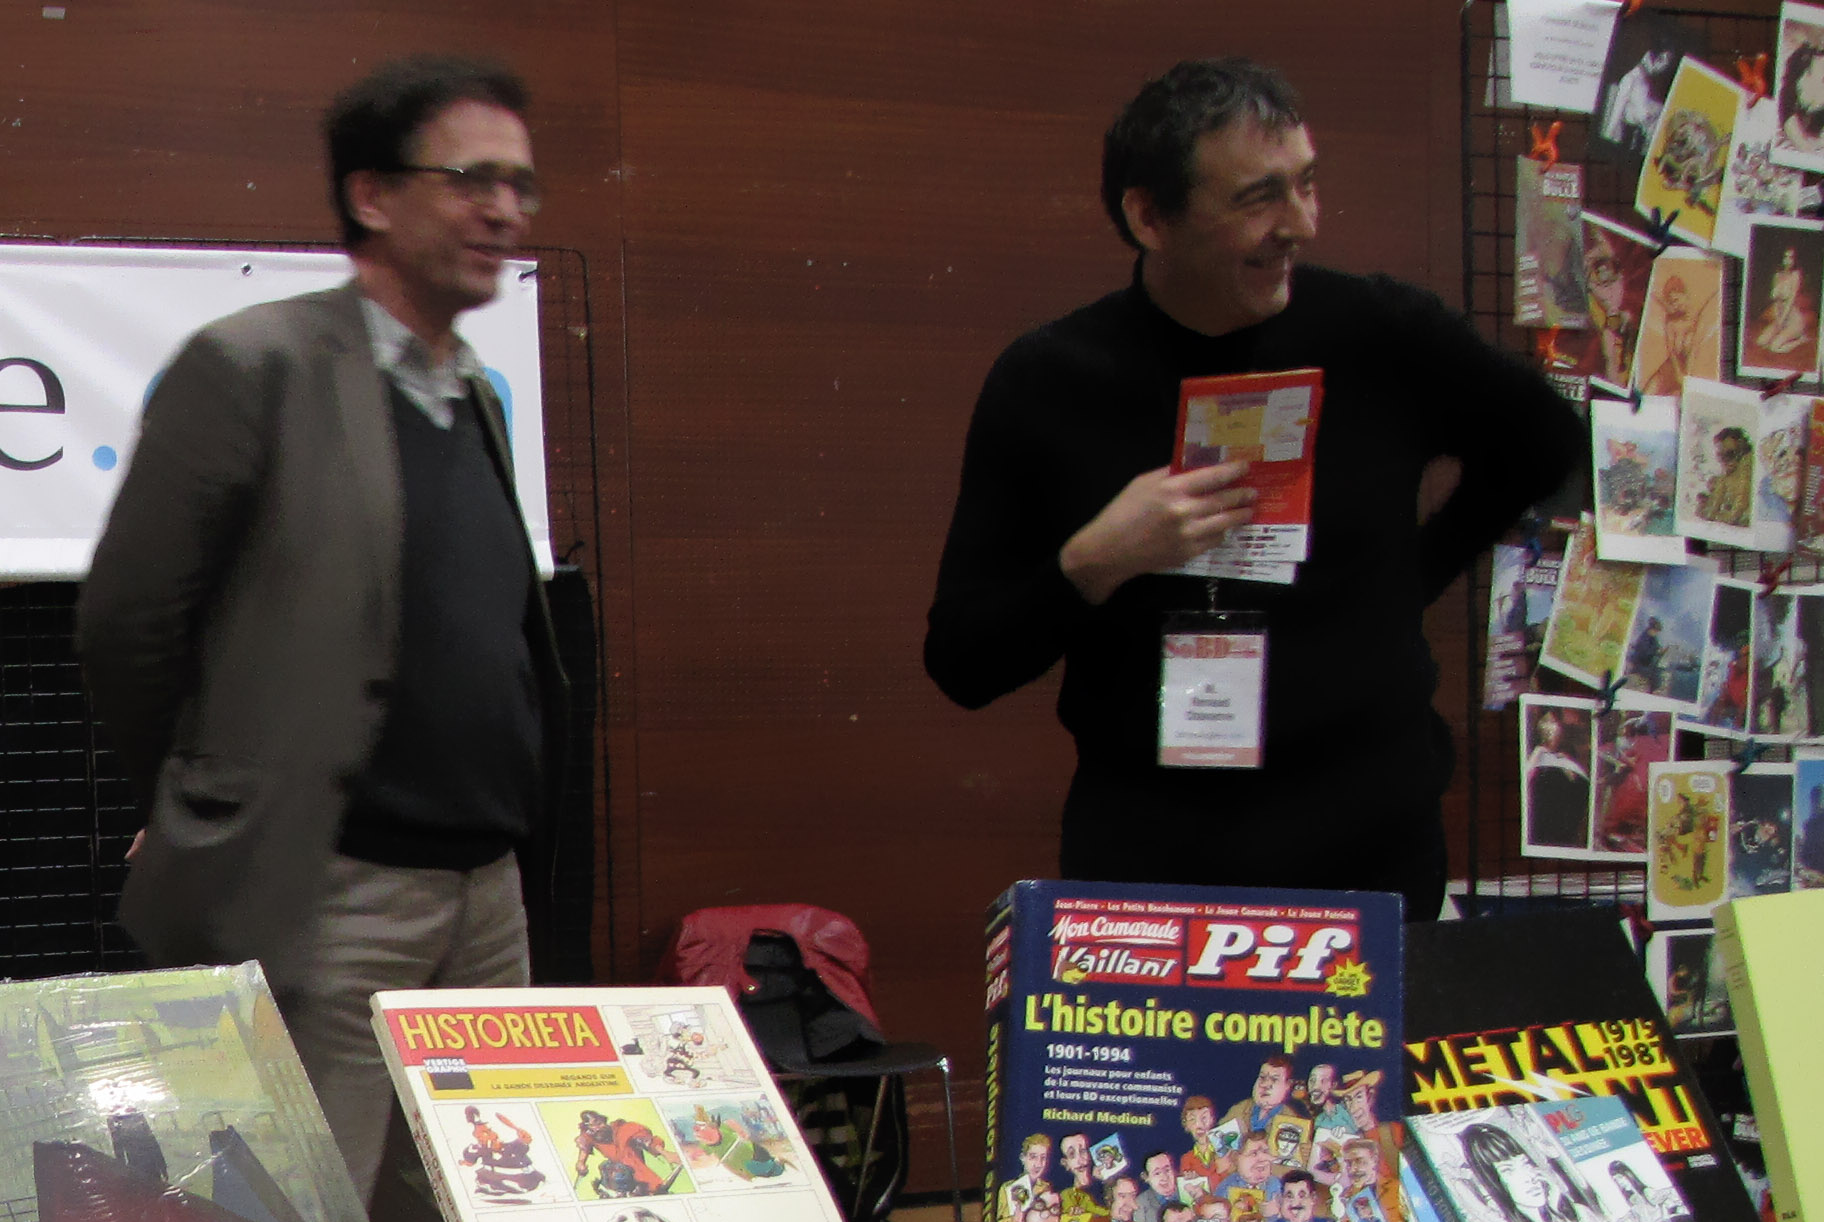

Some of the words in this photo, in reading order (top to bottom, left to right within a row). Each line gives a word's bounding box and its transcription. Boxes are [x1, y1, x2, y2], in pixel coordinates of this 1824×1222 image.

[1047, 915, 1088, 944] Mon
[1088, 916, 1180, 940] Camarade
[1052, 946, 1177, 981] Vaillant
[1187, 923, 1352, 980] Pif
[398, 1012, 601, 1051] HISTORIETA
[1025, 993, 1193, 1040] L'histoire
[1205, 1005, 1385, 1054] complète
[1591, 1018, 1658, 1043] 1975
[1046, 1044, 1131, 1062] 1901-1994
[1602, 1040, 1673, 1069] 1987
[1044, 1065, 1061, 1075] Les
[1062, 1065, 1108, 1078] journaux
[1108, 1069, 1132, 1080] pour
[1134, 1070, 1173, 1081] enfants
[1044, 1077, 1056, 1087] de
[1070, 1080, 1121, 1091] mouvance
[1122, 1083, 1183, 1094] communiste
[1056, 1090, 1081, 1101] leurs
[1083, 1091, 1098, 1101] BD
[1042, 1108, 1094, 1122] Richard
[1096, 1111, 1153, 1126] Medioni
